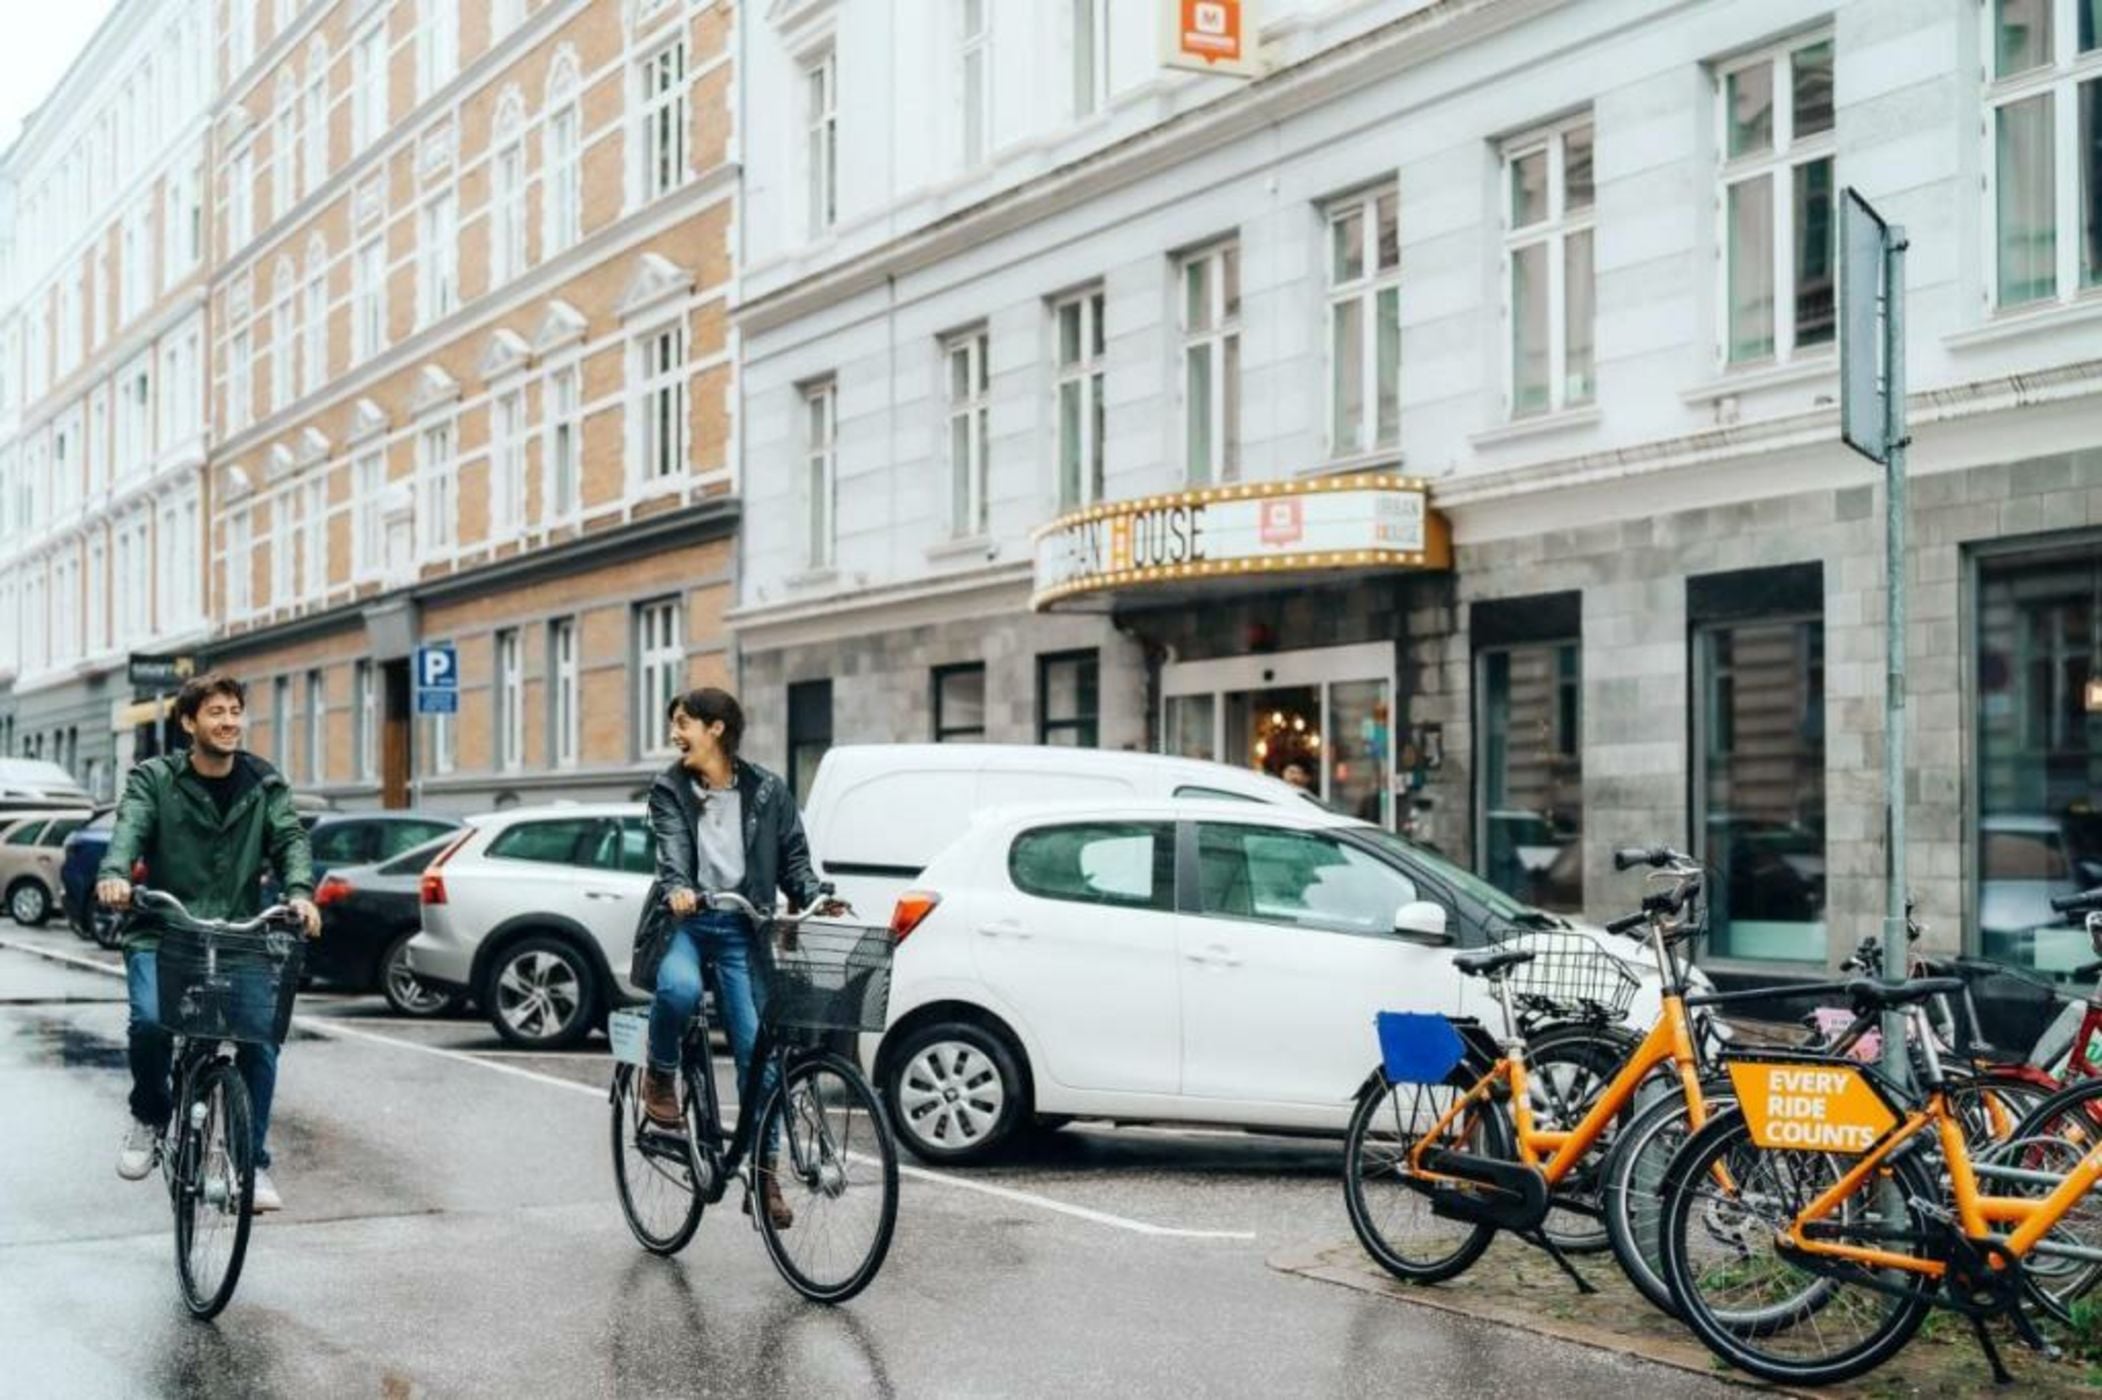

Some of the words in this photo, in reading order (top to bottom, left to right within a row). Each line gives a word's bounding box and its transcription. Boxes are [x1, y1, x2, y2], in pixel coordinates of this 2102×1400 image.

[425, 650, 450, 685] P
[1768, 1070, 1850, 1095] EVERY
[1767, 1095, 1827, 1119] RIDE
[1766, 1121, 1875, 1148] COUNTS
